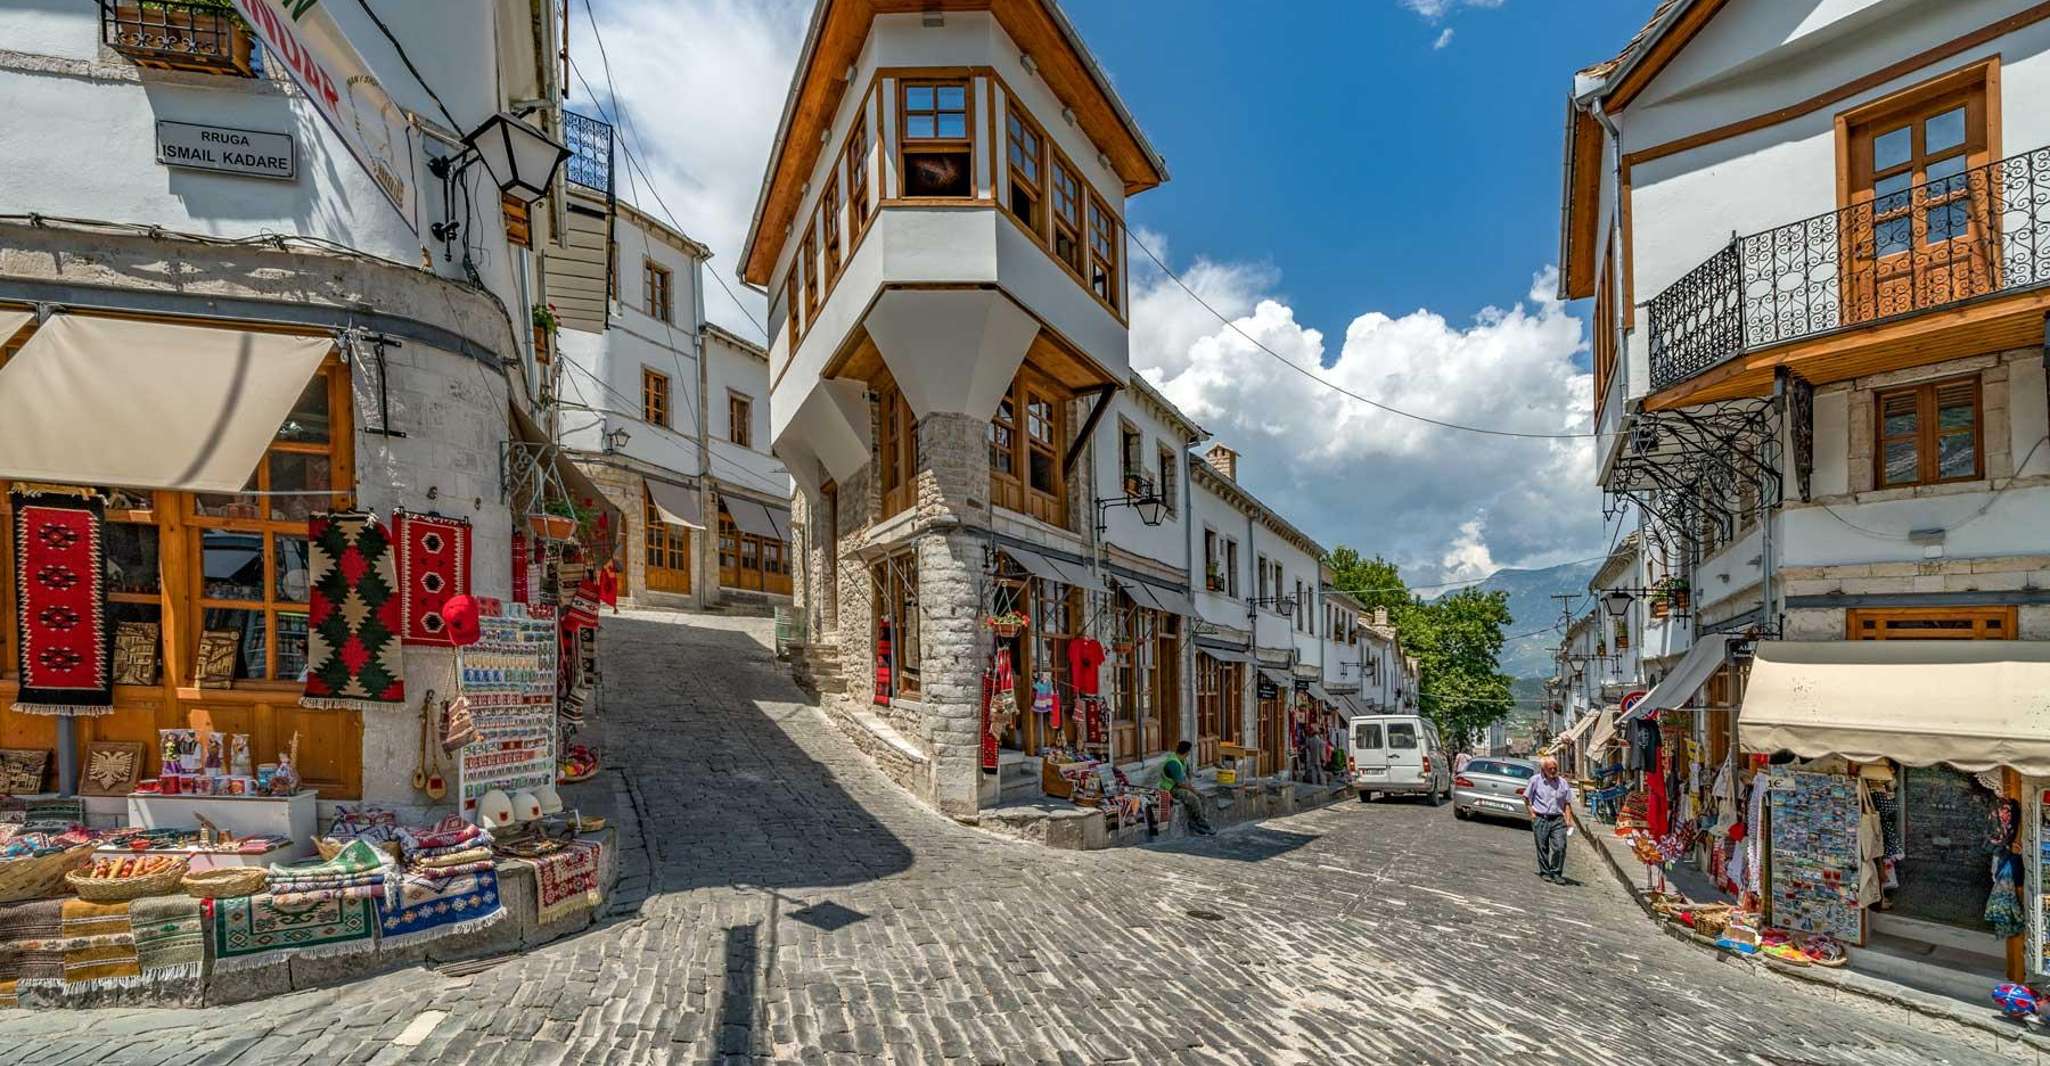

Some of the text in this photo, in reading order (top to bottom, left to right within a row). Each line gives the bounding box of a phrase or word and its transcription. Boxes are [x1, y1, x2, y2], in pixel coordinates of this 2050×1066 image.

[201, 131, 250, 146] RRUGA
[162, 144, 288, 170] ISMAIL KADARE
